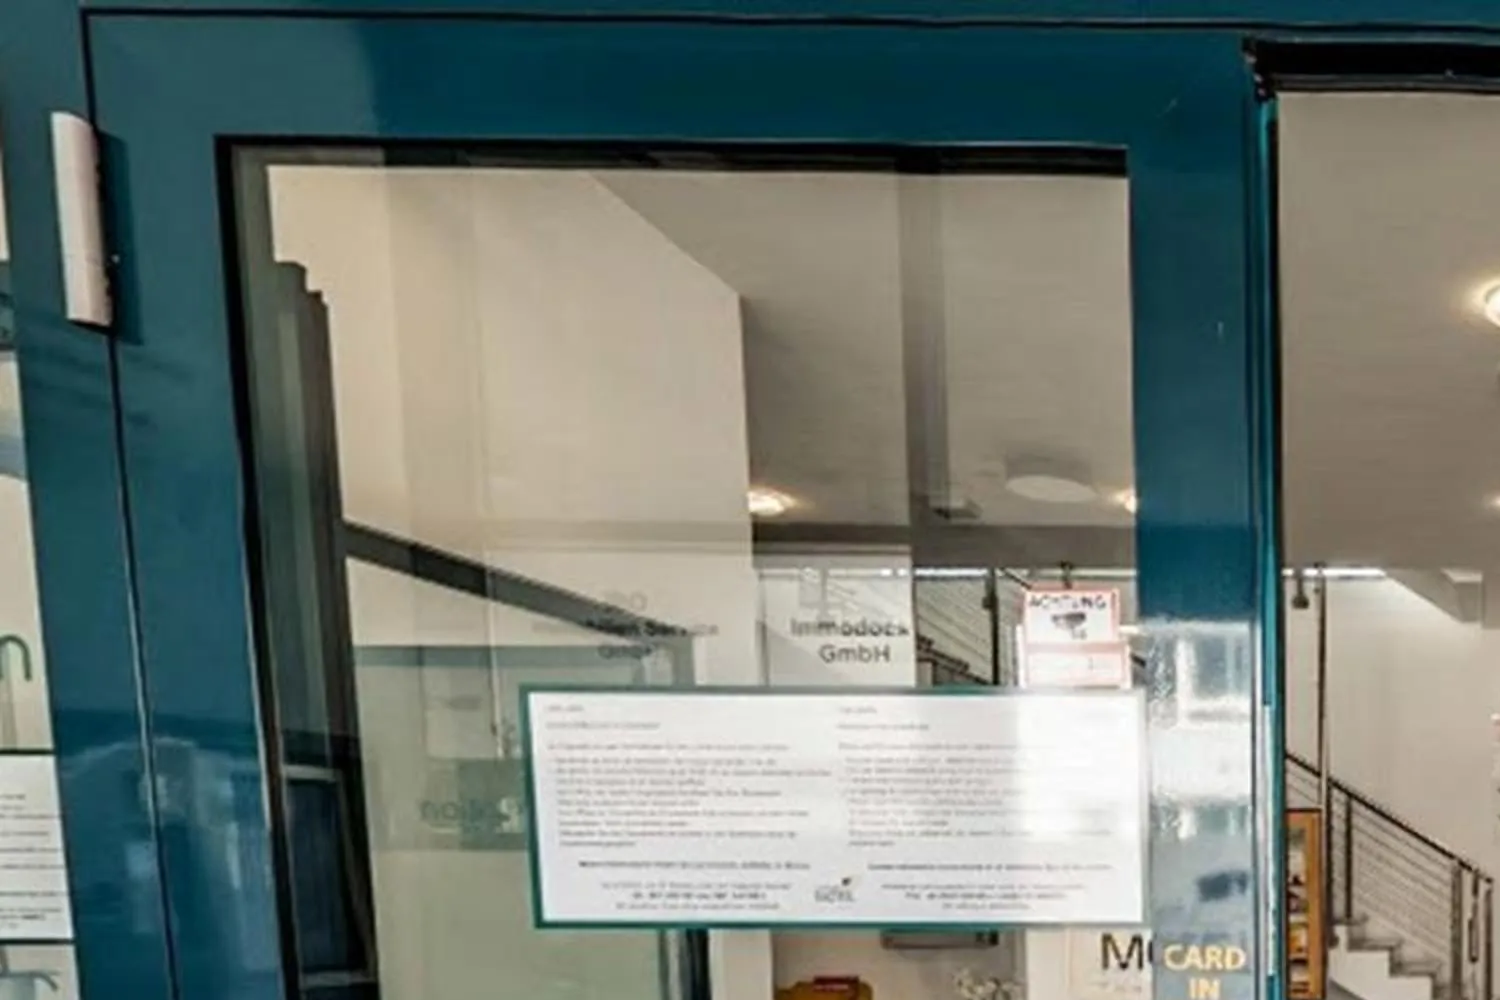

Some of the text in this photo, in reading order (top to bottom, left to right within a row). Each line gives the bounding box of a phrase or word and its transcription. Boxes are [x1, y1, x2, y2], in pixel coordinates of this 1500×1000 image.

[818, 643, 892, 665] GmbH
[1101, 932, 1154, 970] M
[1164, 943, 1246, 971] CARD
[1189, 977, 1220, 1000] IN
